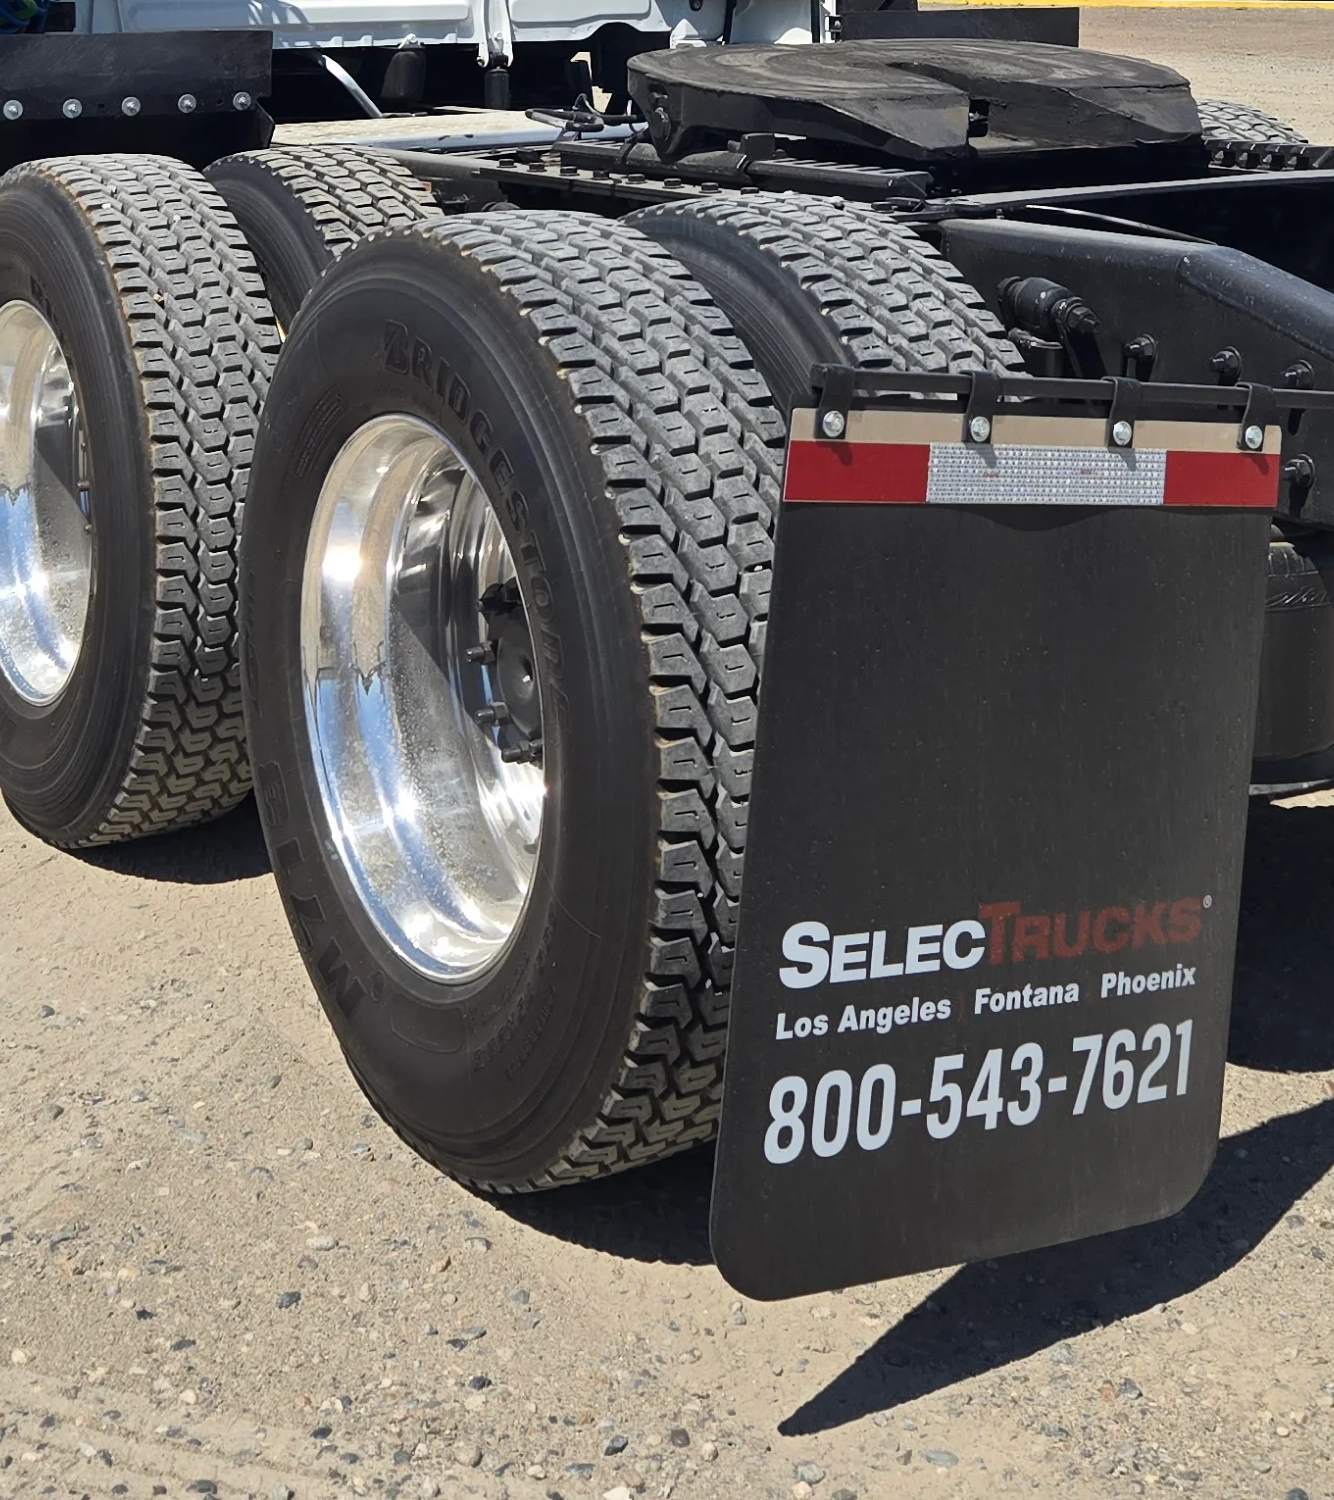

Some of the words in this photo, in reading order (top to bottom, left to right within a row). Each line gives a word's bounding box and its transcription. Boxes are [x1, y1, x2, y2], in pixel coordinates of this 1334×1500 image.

[775, 1012, 828, 1041] Los
[837, 997, 951, 1035] Angeles
[974, 983, 1079, 1014] Fontana
[1101, 964, 1197, 998] Phoenix
[763, 1019, 1193, 1164] 800-543-7621
